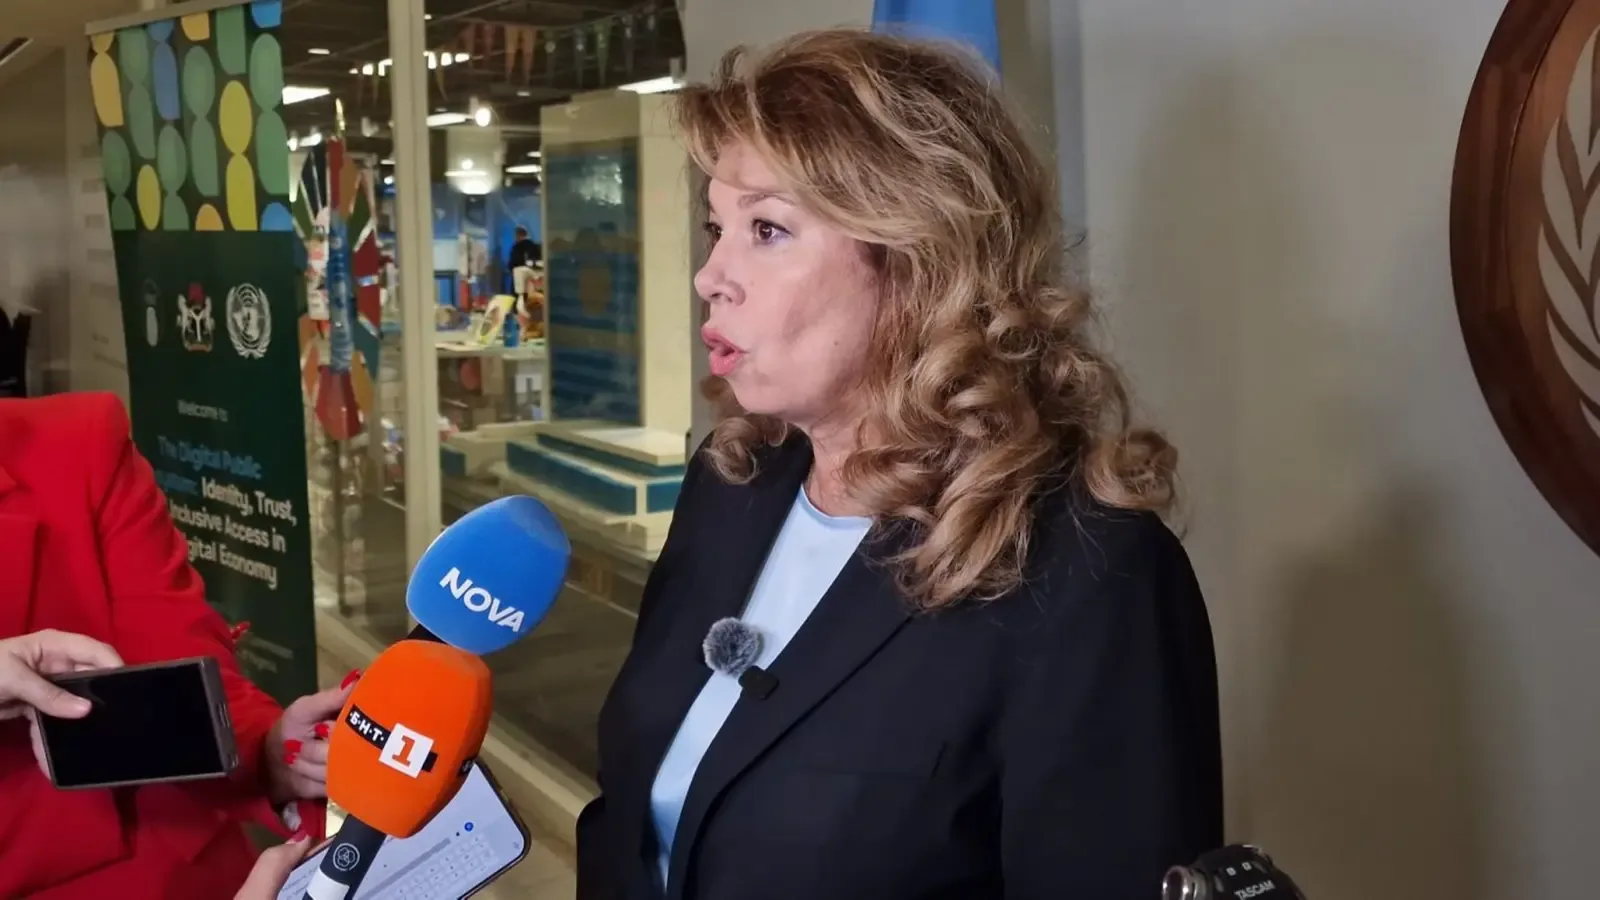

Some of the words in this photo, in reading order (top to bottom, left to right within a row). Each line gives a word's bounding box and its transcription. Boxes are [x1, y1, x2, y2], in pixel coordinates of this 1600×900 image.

[178, 399, 218, 420] Welcome
[179, 440, 221, 472] Digital
[222, 450, 262, 480] Public
[201, 476, 253, 517] Identity,
[254, 490, 297, 527] Trust,
[224, 515, 269, 548] Access
[272, 527, 286, 553] in
[219, 544, 278, 590] Economy
[439, 567, 525, 632] NOVA
[391, 735, 415, 768] 1
[1234, 880, 1276, 900] TASCAM
